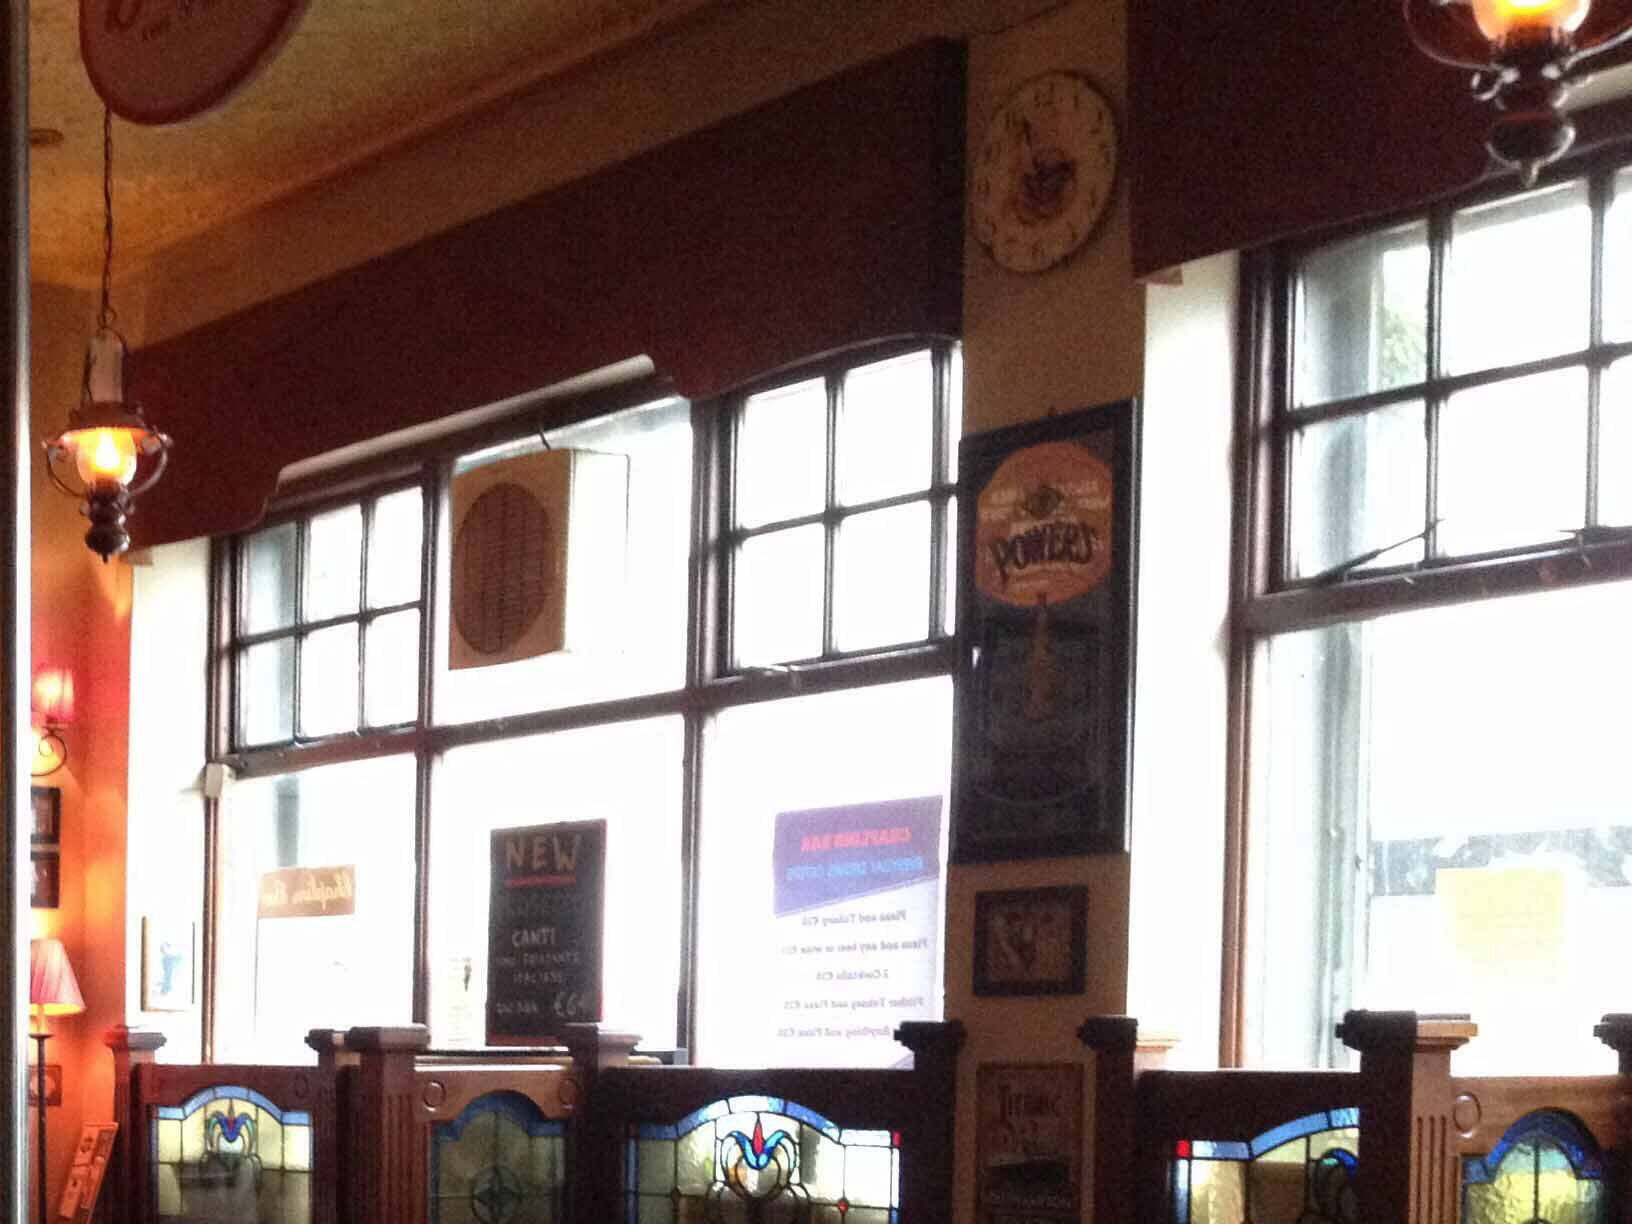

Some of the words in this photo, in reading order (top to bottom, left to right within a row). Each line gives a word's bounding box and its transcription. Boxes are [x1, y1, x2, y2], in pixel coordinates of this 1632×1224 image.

[990, 518, 1096, 584] POWERS
[505, 834, 581, 873] NEW
[512, 927, 556, 948] CANTI
